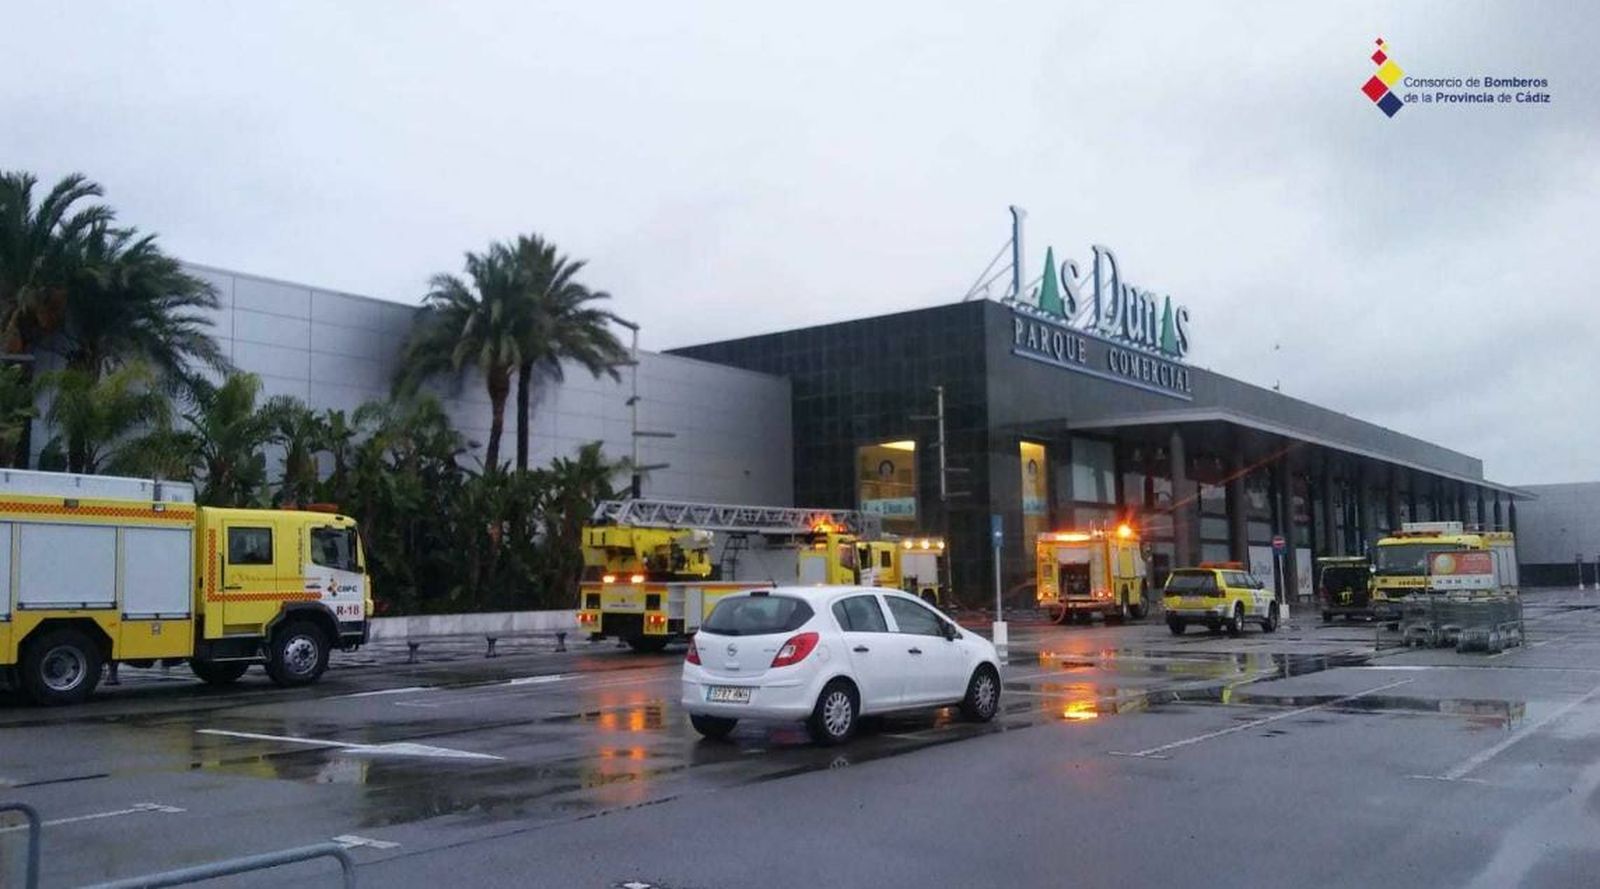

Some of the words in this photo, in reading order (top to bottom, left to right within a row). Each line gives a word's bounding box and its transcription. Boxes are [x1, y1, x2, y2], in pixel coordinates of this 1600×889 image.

[1014, 317, 1087, 364] PARQUE
[1108, 347, 1192, 393] COMERCIAL
[336, 603, 360, 616] R-18
